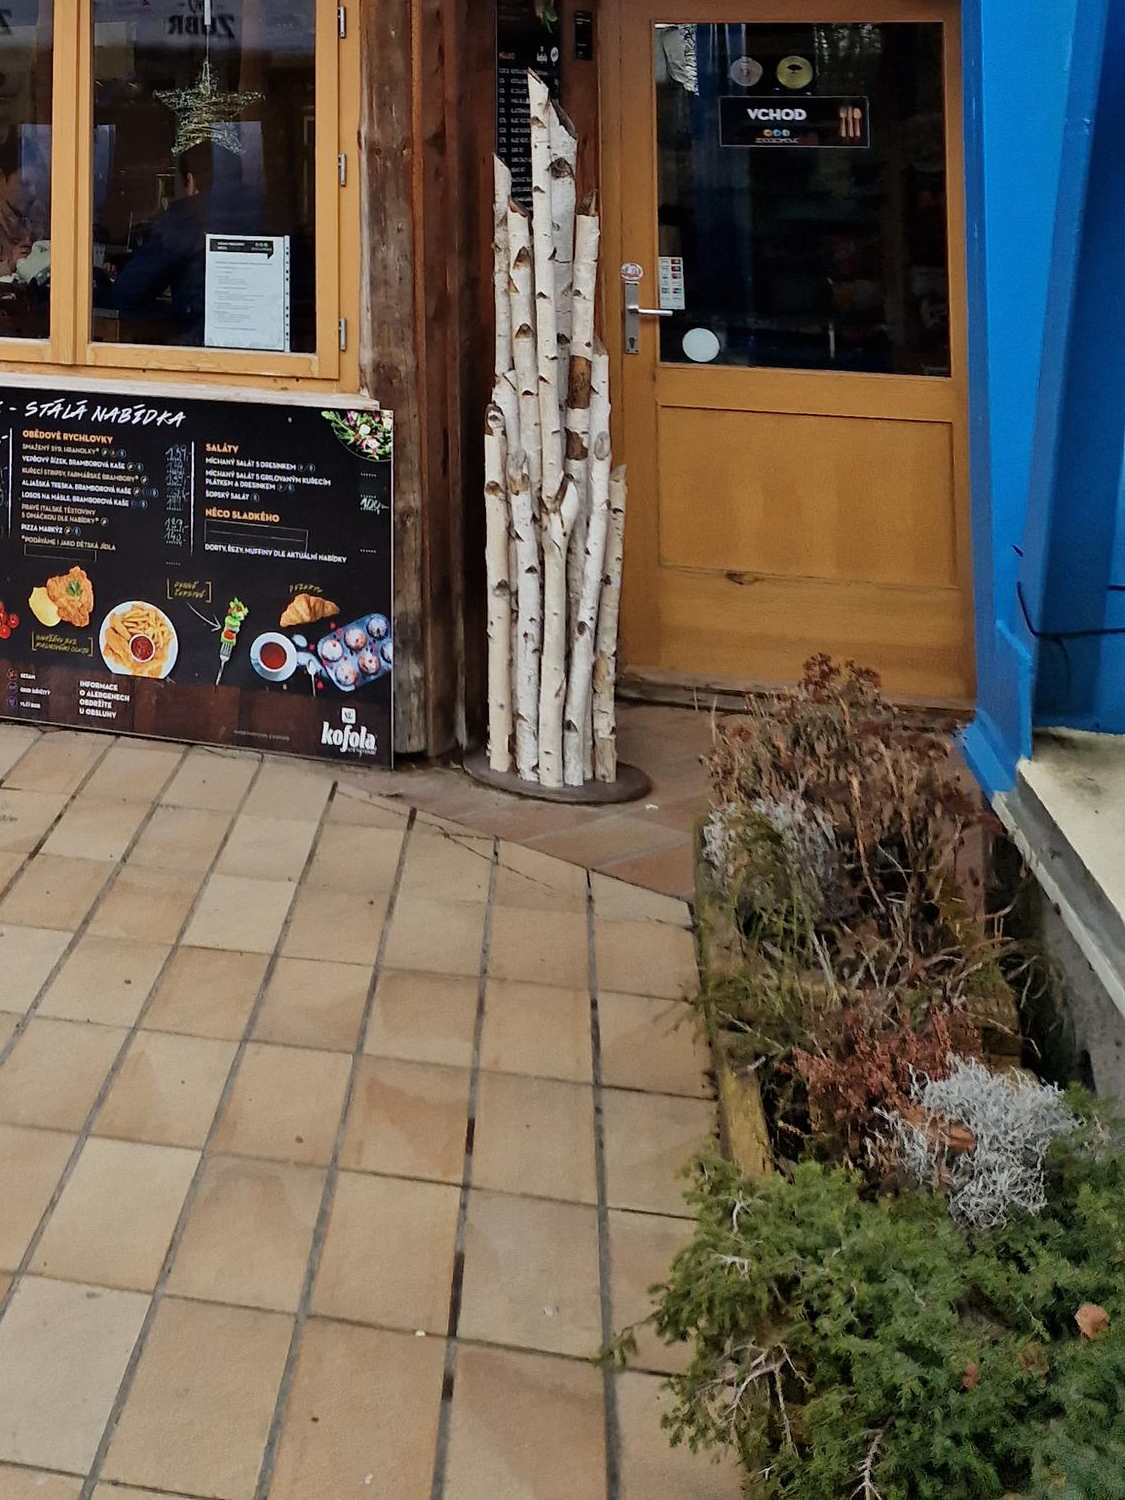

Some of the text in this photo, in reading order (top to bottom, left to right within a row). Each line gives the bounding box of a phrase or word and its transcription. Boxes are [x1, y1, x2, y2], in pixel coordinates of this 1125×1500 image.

[747, 108, 807, 120] VCHOD
[25, 399, 88, 421] STÁLÁ
[91, 404, 186, 428] NABÍDKA
[23, 429, 113, 444] OBĚDOVÉ RYCHLOVKY
[22, 443, 49, 451] SMAŽENÝ
[206, 443, 239, 453] SALÁTY
[22, 455, 49, 463] VEPŘOVÝ
[69, 459, 109, 468] BRAMBOROVÁ
[206, 457, 235, 466] MÍCHANÝ
[236, 459, 255, 468] SALÁT
[22, 467, 43, 475] KUŘECÍ
[67, 471, 101, 480] FARMÁŘSKÉ
[206, 470, 235, 478] MÍCHANÝ
[236, 472, 255, 480] SALÁT
[302, 476, 331, 486] KUŘECÍM
[22, 480, 50, 488] ALJAŠSKÁ
[75, 484, 115, 493] BRAMBOROVÁ
[116, 487, 132, 495] KAŠE
[206, 478, 233, 487] PLÁTKEM
[206, 489, 250, 501] ŠOPSKÝ SALÁT
[73, 496, 113, 505] BRAMBOROVÁ
[114, 499, 129, 507] KAŠE
[40, 505, 62, 513] ITALSKÉ
[64, 507, 96, 515] TĚSTOVINY
[205, 506, 280, 523] NĚCO SLADKÉHO
[39, 525, 63, 534] MARKÝZ
[76, 540, 98, 548] DĚTSKÁ
[100, 542, 116, 550] JÍDLA
[245, 548, 272, 557] MUFFINY
[274, 550, 285, 558] DLE
[287, 550, 317, 560] AKTUÁLNÍ
[319, 554, 347, 563] NABÍDKY
[80, 681, 118, 691] INFORMACE
[87, 691, 130, 702] ALERGENECH
[79, 699, 112, 708] OBDRŽÍTE
[86, 708, 116, 718] OBSLUHY
[321, 721, 376, 752] kofola
